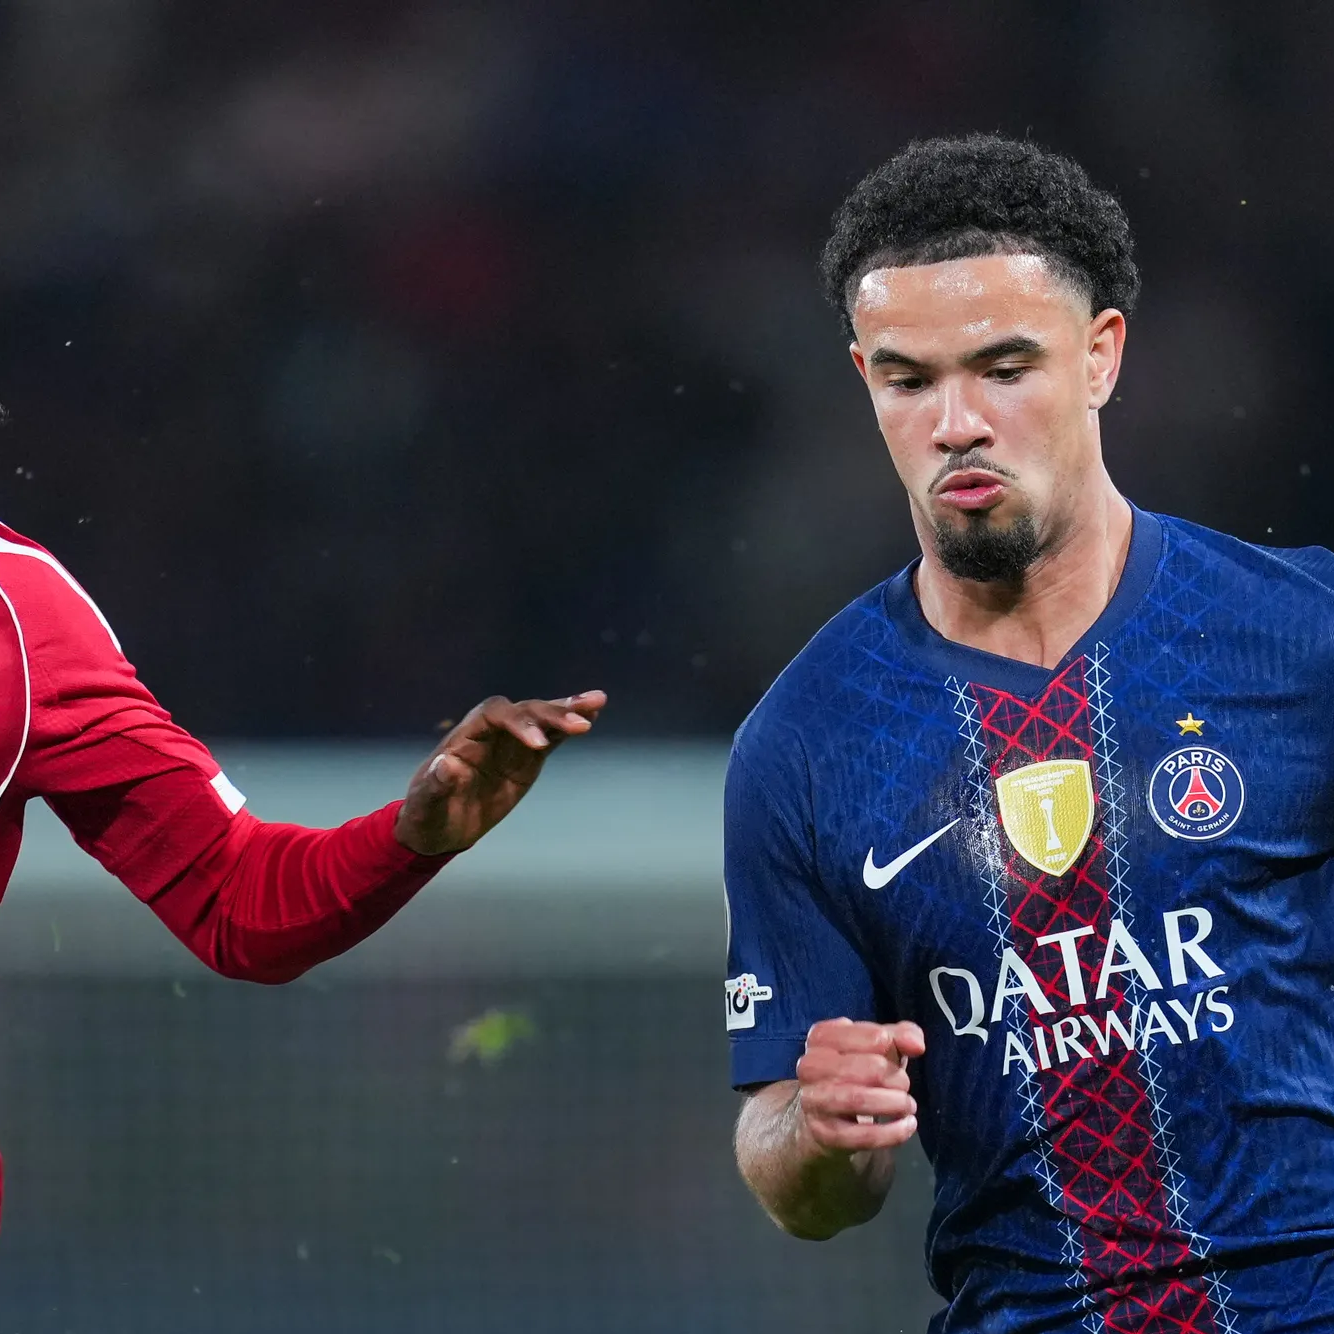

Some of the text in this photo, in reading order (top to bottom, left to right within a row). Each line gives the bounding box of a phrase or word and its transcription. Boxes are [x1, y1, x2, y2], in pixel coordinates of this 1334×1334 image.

[1163, 751, 1226, 776] PARIS
[1168, 815, 1191, 831] SAINT
[1197, 812, 1230, 832] GERMAIN
[928, 906, 1226, 1046] QATAR
[1002, 985, 1235, 1076] AIRWAYS
